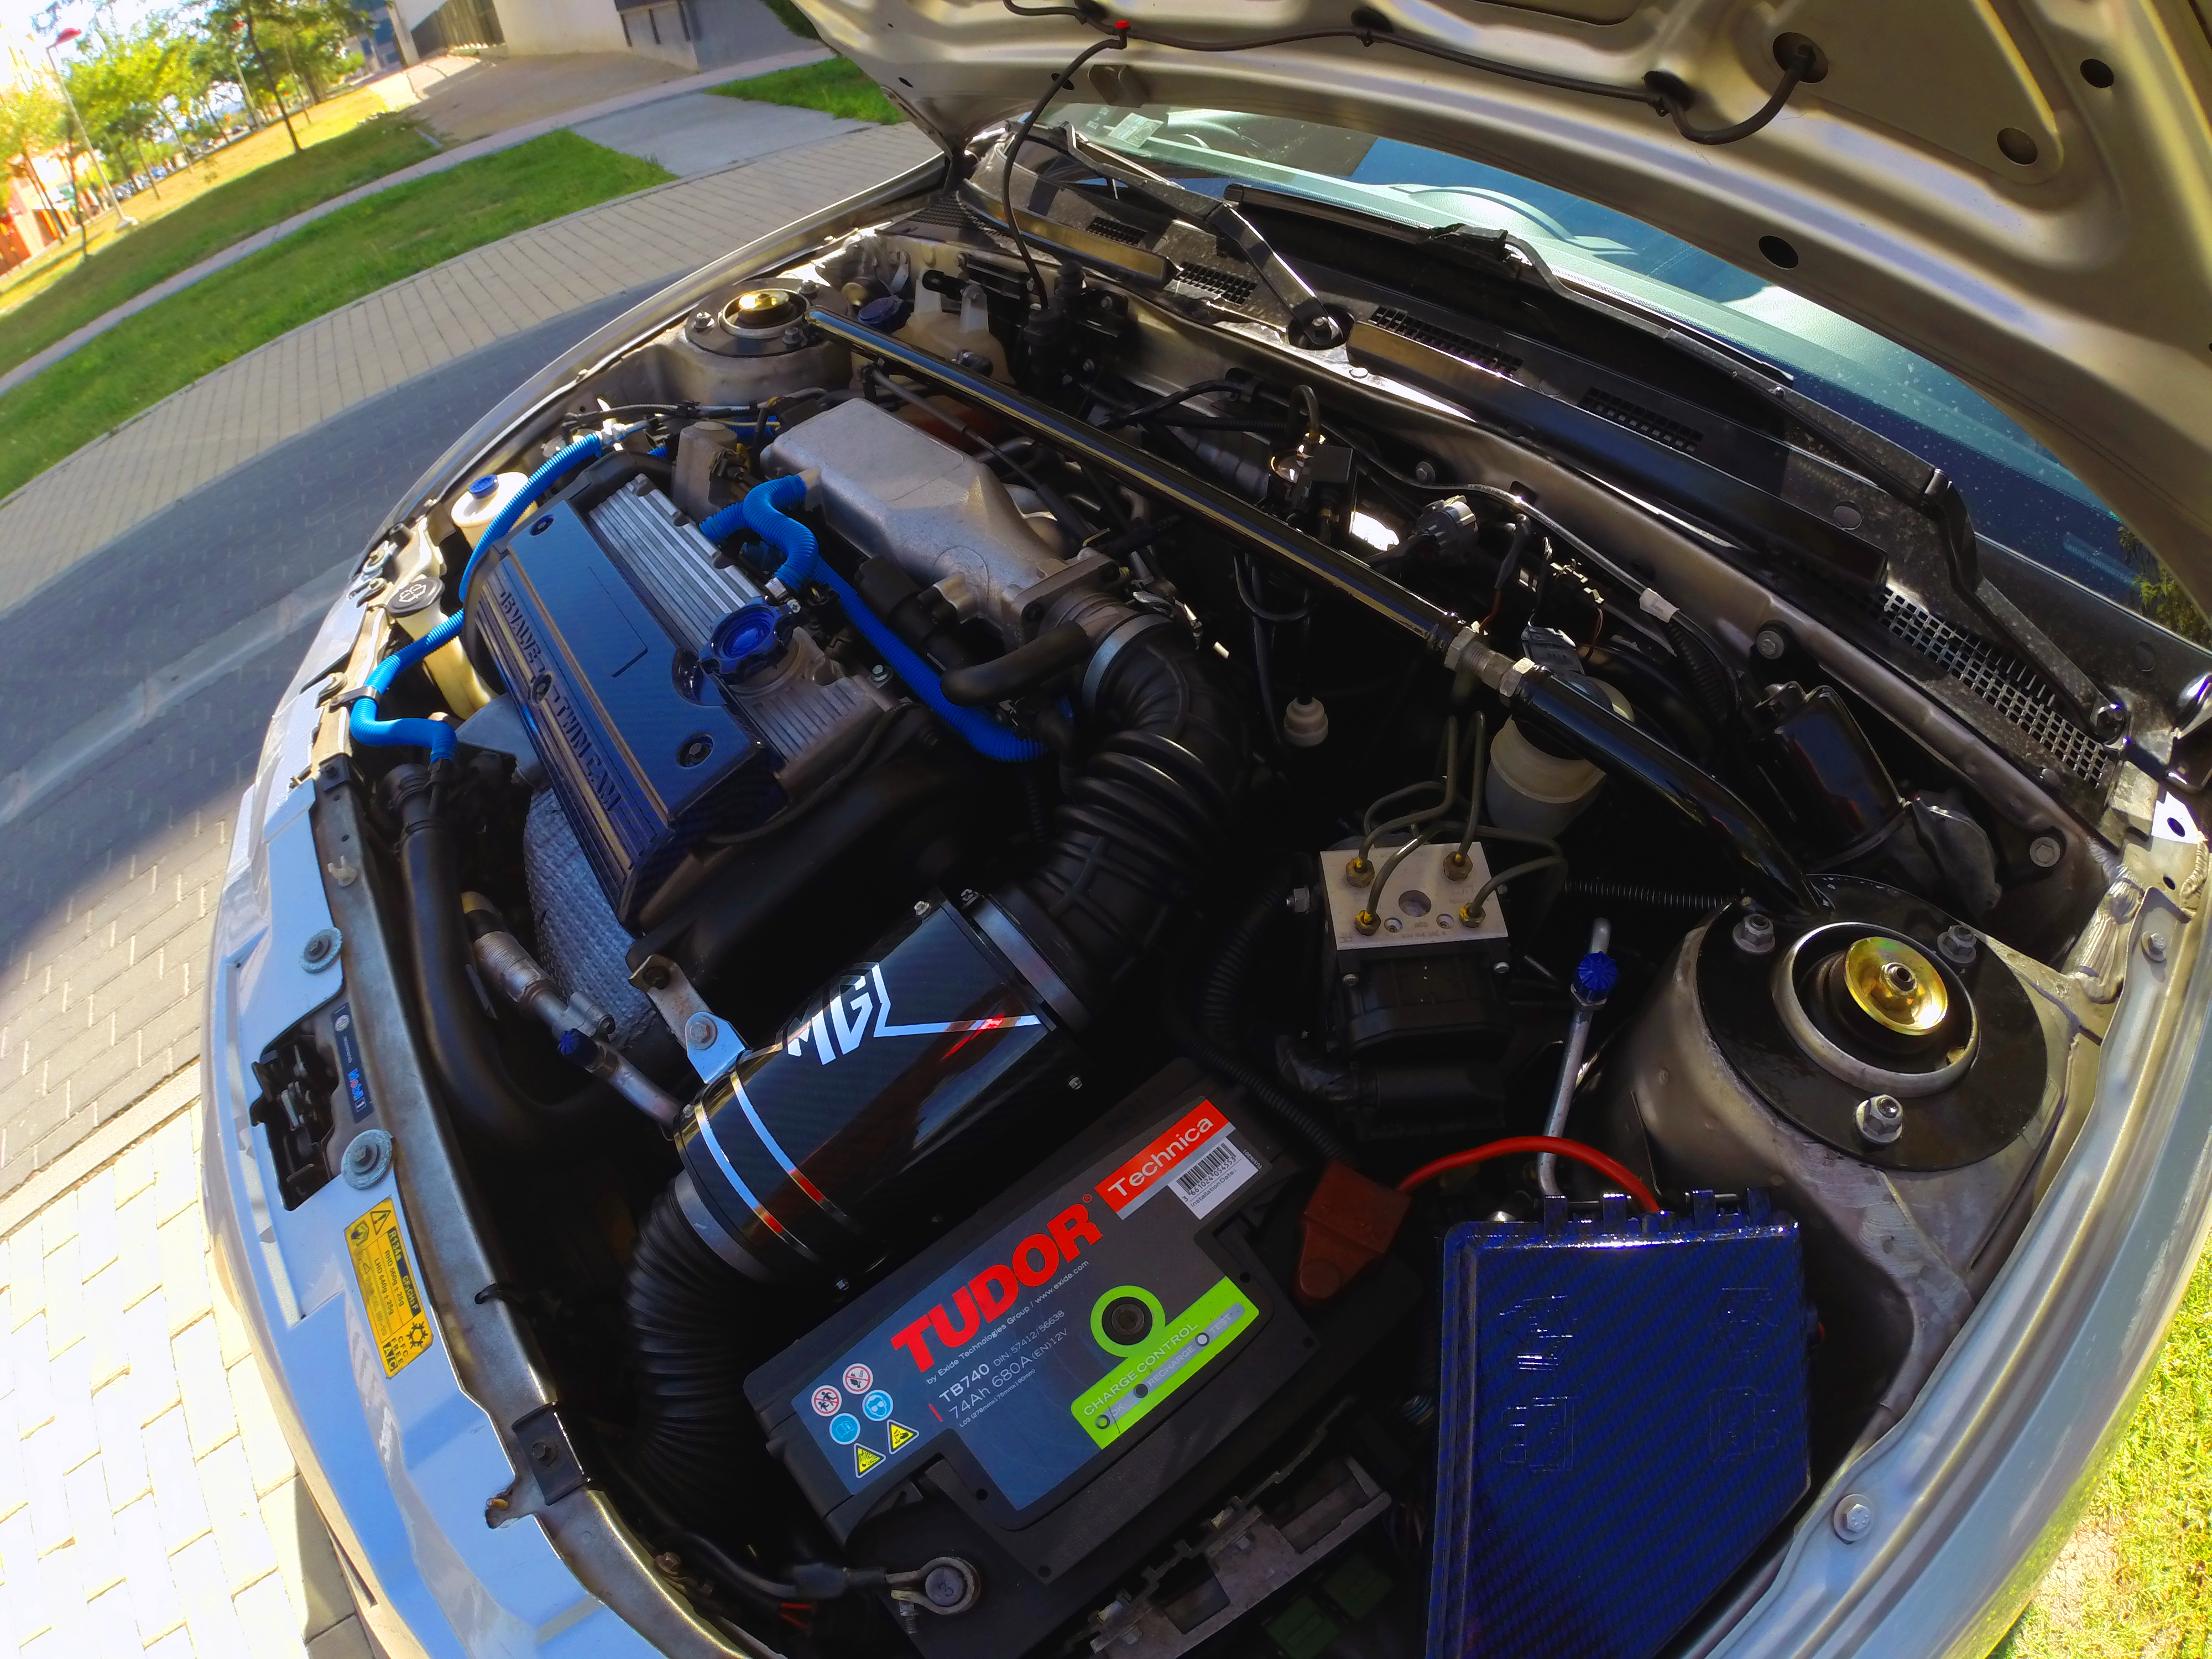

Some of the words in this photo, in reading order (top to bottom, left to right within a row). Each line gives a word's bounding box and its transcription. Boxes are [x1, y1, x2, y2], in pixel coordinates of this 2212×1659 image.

[511, 608, 542, 663] VALVE
[558, 697, 592, 758] TWIN
[587, 757, 622, 812] CAM
[348, 1068, 364, 1100] Mobil
[1107, 1118, 1214, 1197] Technica
[1190, 1176, 1213, 1196] 661024
[1214, 1156, 1237, 1176] 054553
[1190, 1182, 1221, 1207] Installation
[388, 1229, 401, 1262] R134a
[374, 1258, 383, 1274] LHD
[379, 1274, 388, 1295] 640g
[385, 1249, 393, 1265] RHD
[389, 1265, 398, 1286] 560g
[890, 1203, 1103, 1373] TUDOR
[926, 1375, 937, 1385] by
[937, 1359, 959, 1376] Exide
[958, 1324, 1007, 1360] Technologies
[1006, 1305, 1030, 1326] Group
[1035, 1260, 1089, 1305] www.exide.com
[383, 1345, 398, 1371] A/C
[391, 1337, 404, 1364] FREE
[398, 1336, 409, 1358] CFC
[938, 1363, 990, 1403] TB740
[1010, 1310, 1066, 1354] 57412/56638
[1111, 1403, 1125, 1417] OK
[1147, 1345, 1195, 1387] RECHARGE
[1208, 1313, 1232, 1334] TEST
[1083, 1370, 1138, 1416] CHARGE
[1136, 1323, 1198, 1374] CONTROL
[949, 1386, 991, 1420] 74Ah
